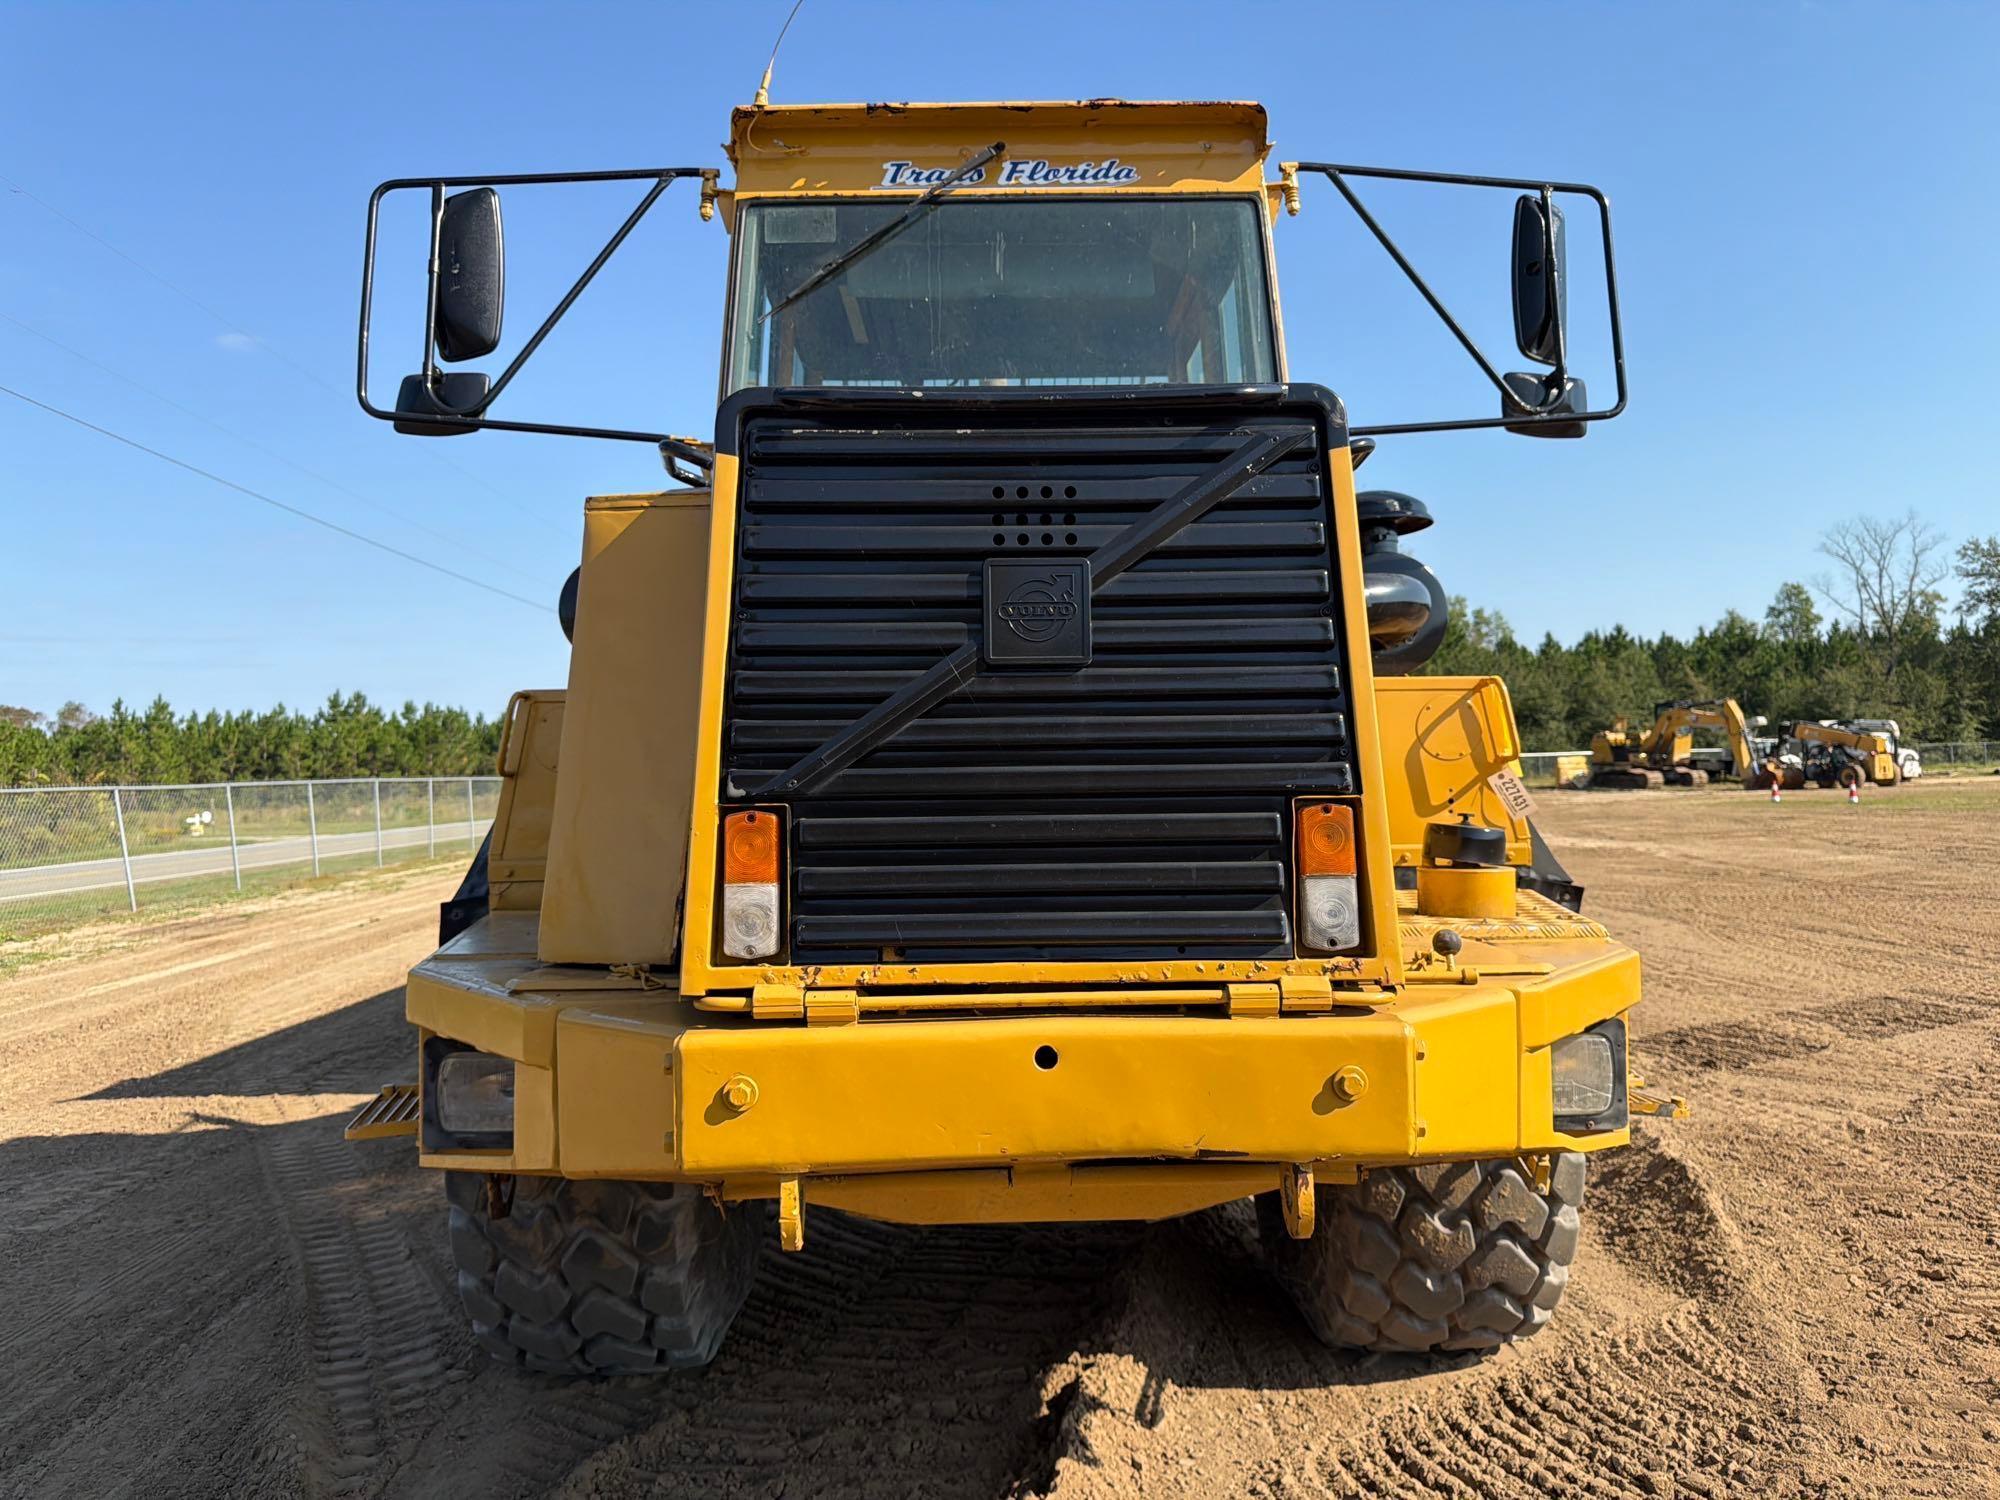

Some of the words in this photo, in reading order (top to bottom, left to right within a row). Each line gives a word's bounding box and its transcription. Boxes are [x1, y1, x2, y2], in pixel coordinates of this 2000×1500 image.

[884, 161, 985, 185] Tras
[1001, 159, 1136, 184] Florida
[1000, 604, 1074, 617] VOLVO
[1502, 778, 1529, 811] 227431
